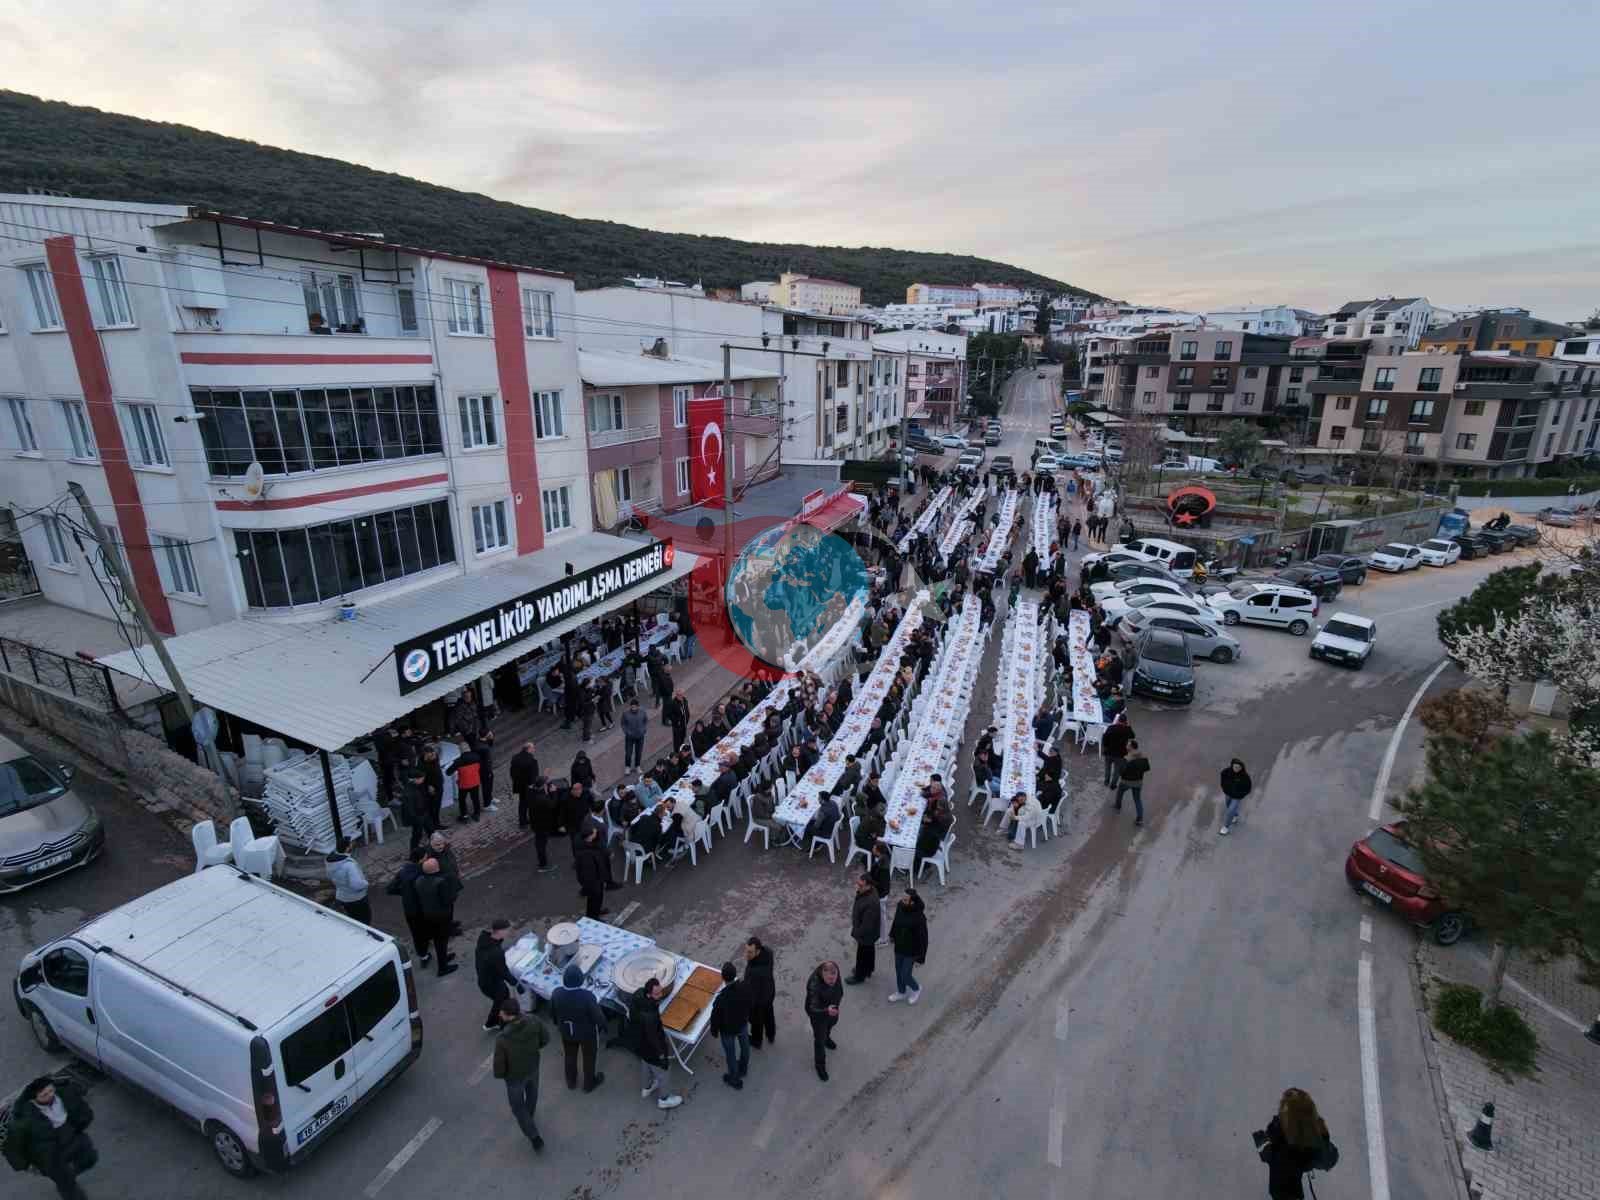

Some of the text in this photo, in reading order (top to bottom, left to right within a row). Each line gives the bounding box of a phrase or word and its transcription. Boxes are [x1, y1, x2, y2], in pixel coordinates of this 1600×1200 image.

[432, 544, 663, 671] TEKNELİKÜP YARDIMLAŞMA DERNEĞİ
